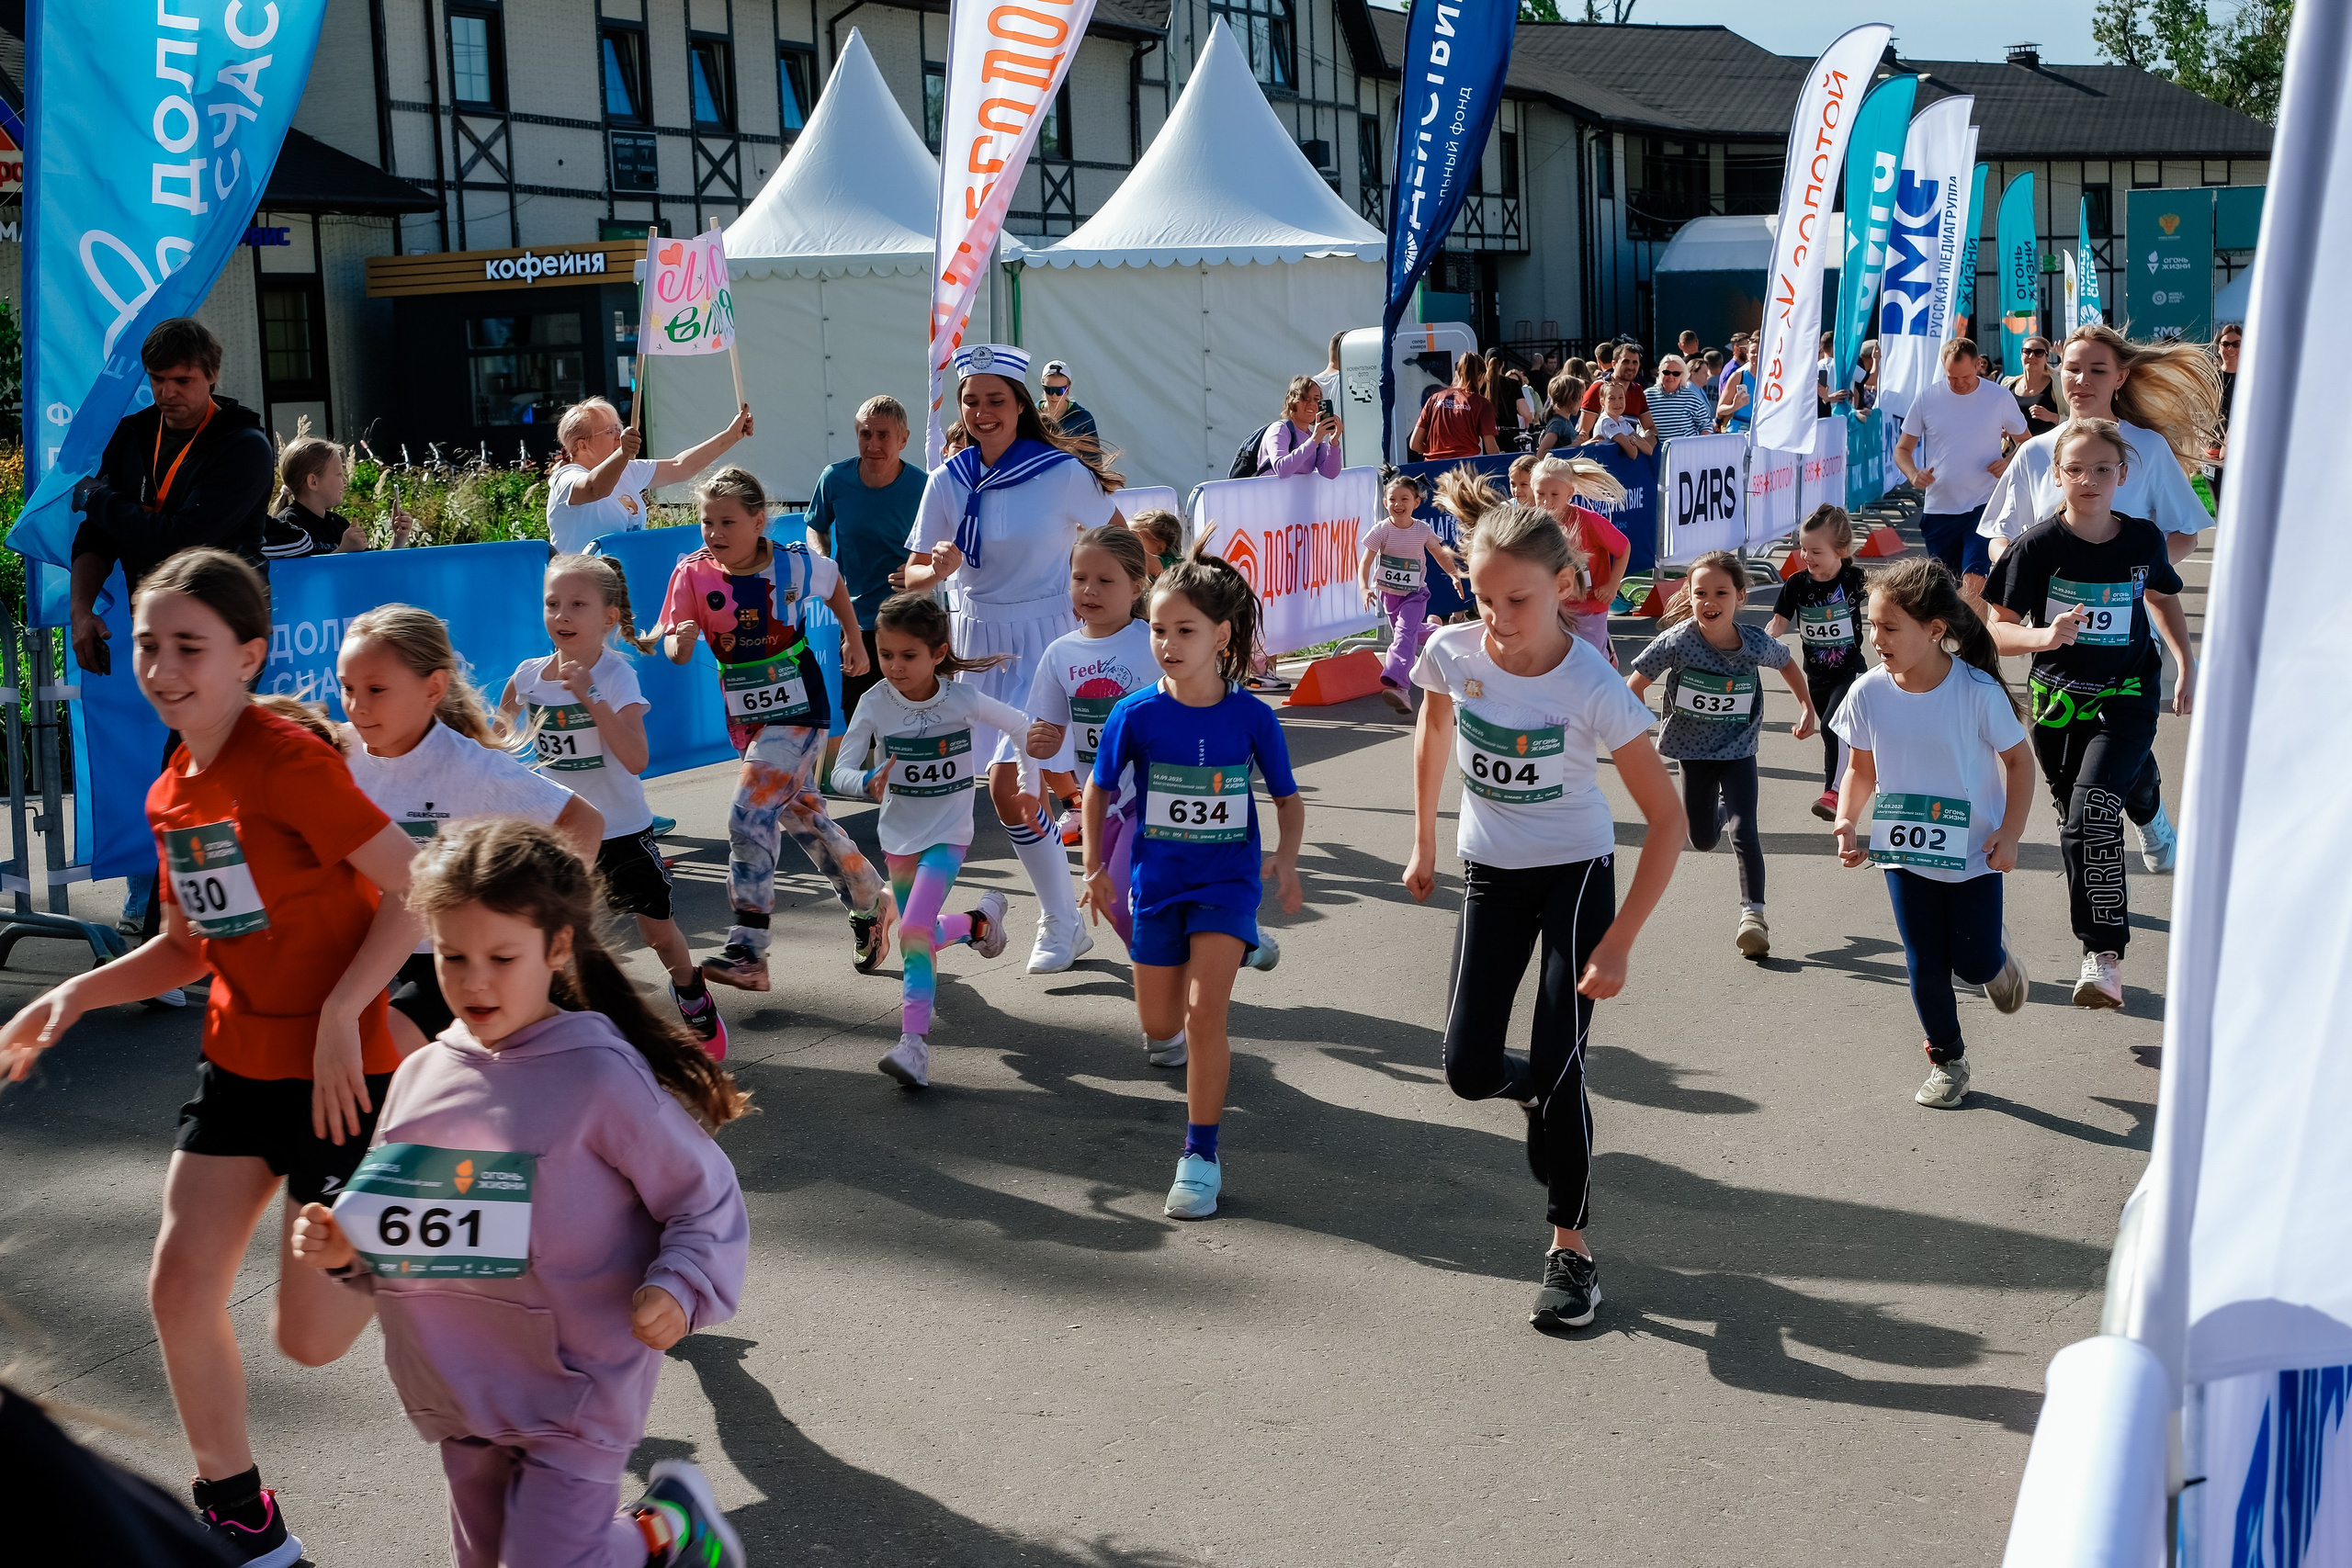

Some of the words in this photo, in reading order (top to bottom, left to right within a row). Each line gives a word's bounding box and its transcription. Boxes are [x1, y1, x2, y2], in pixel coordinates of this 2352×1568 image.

[1449, 87, 1473, 135] фонд
[1939, 175, 1958, 274] МЕДИАГРУППА
[485, 251, 606, 284] кофейня
[2014, 245, 2027, 299] ОГОНЬ
[1929, 276, 1950, 338] РУССКАЯ
[1679, 465, 1736, 525] DARS
[1263, 516, 1360, 614] ДОБРОДОМИК
[1385, 570, 1411, 584] 644
[739, 634, 779, 649] Spotify
[1806, 624, 1840, 637] 646
[1069, 660, 1102, 681] Feel
[743, 686, 790, 711] 654
[1692, 694, 1736, 712] 632
[538, 733, 576, 755] 631
[948, 743, 968, 751] ЖИЗНИ
[1531, 742, 1560, 751] ЖИЗНИ
[905, 761, 956, 783] 640
[1473, 753, 1539, 785] 604
[1169, 799, 1229, 825] 634
[1890, 825, 1946, 851] 602
[2084, 787, 2124, 926] FOREVER
[477, 1180, 526, 1190] ЖИЗНИ
[480, 1170, 524, 1181] ОГОНЬ
[379, 1205, 481, 1247] 661
